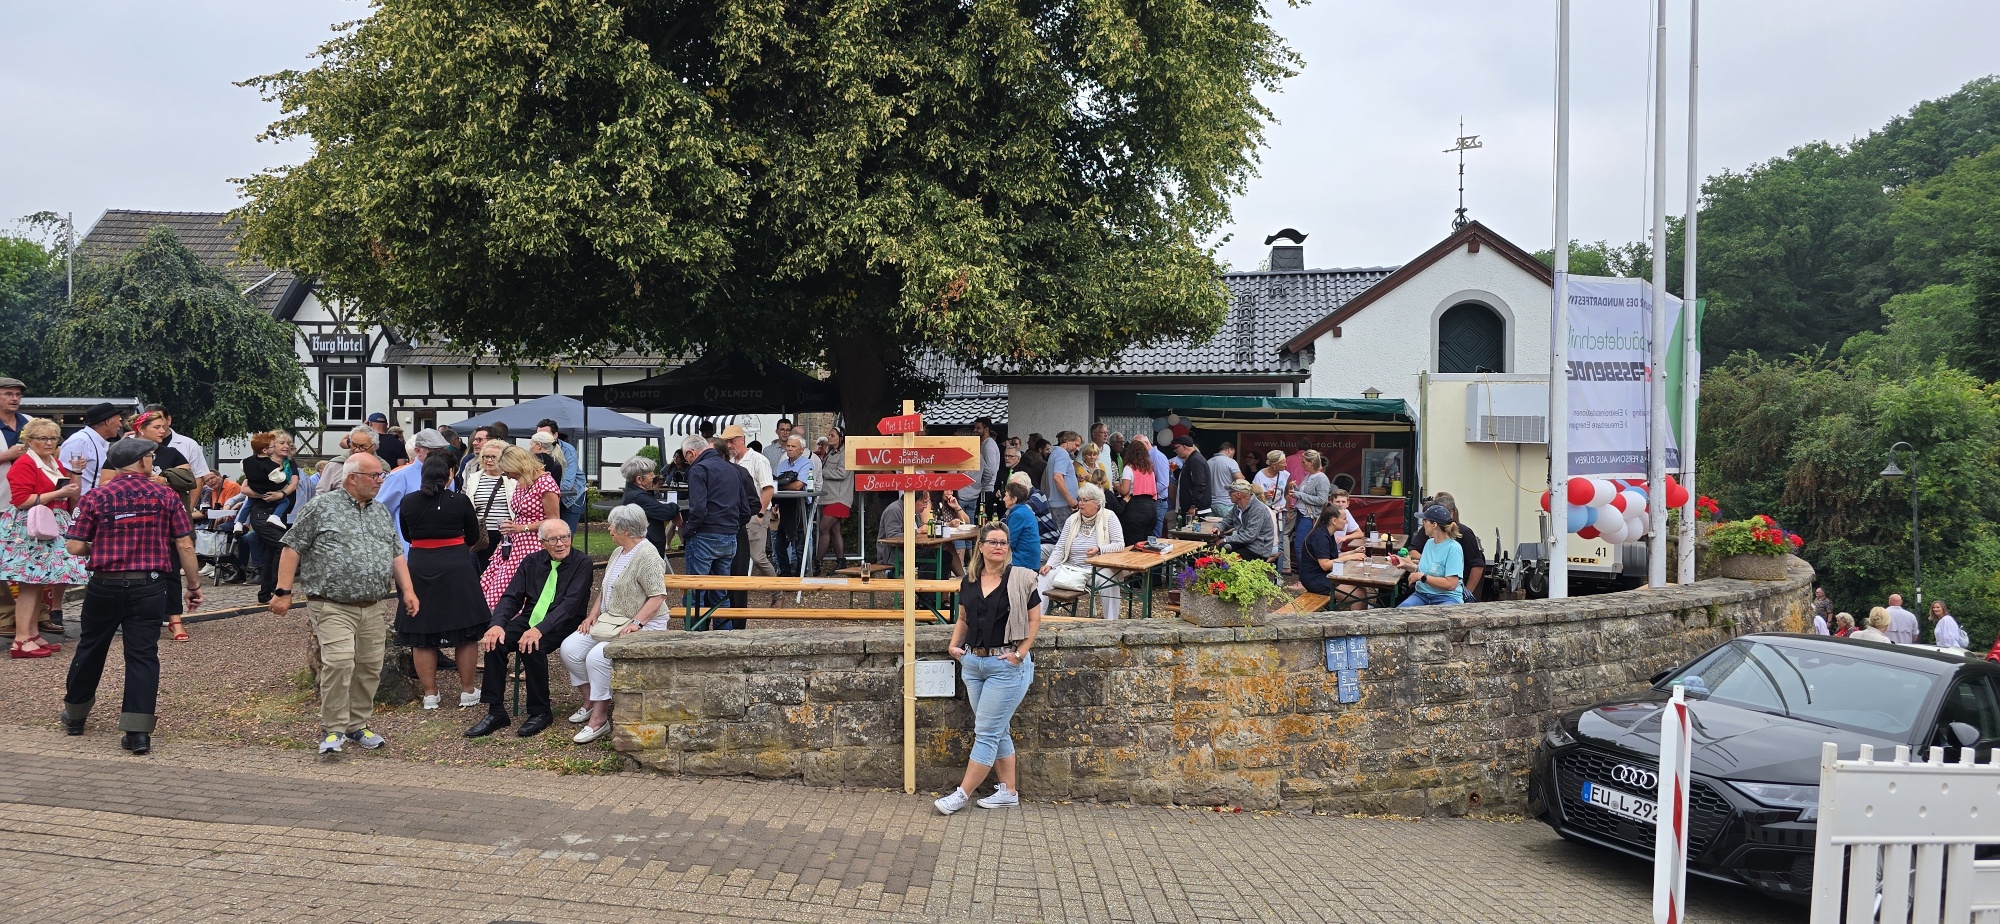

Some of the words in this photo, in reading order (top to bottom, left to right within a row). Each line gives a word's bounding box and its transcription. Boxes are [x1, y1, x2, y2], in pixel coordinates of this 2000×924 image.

[312, 336, 336, 354] Burg
[336, 336, 363, 351] Hotel
[619, 390, 660, 398] XLMOTO
[720, 389, 762, 398] XLMOTO
[868, 449, 891, 464] WC
[864, 475, 901, 490] Beauty
[914, 475, 945, 489] Style
[1595, 547, 1606, 557] 41
[1329, 643, 1335, 651] S
[1350, 641, 1355, 649] S
[1341, 675, 1347, 684] S
[1591, 786, 1611, 807] EU
[1620, 795, 1629, 812] L
